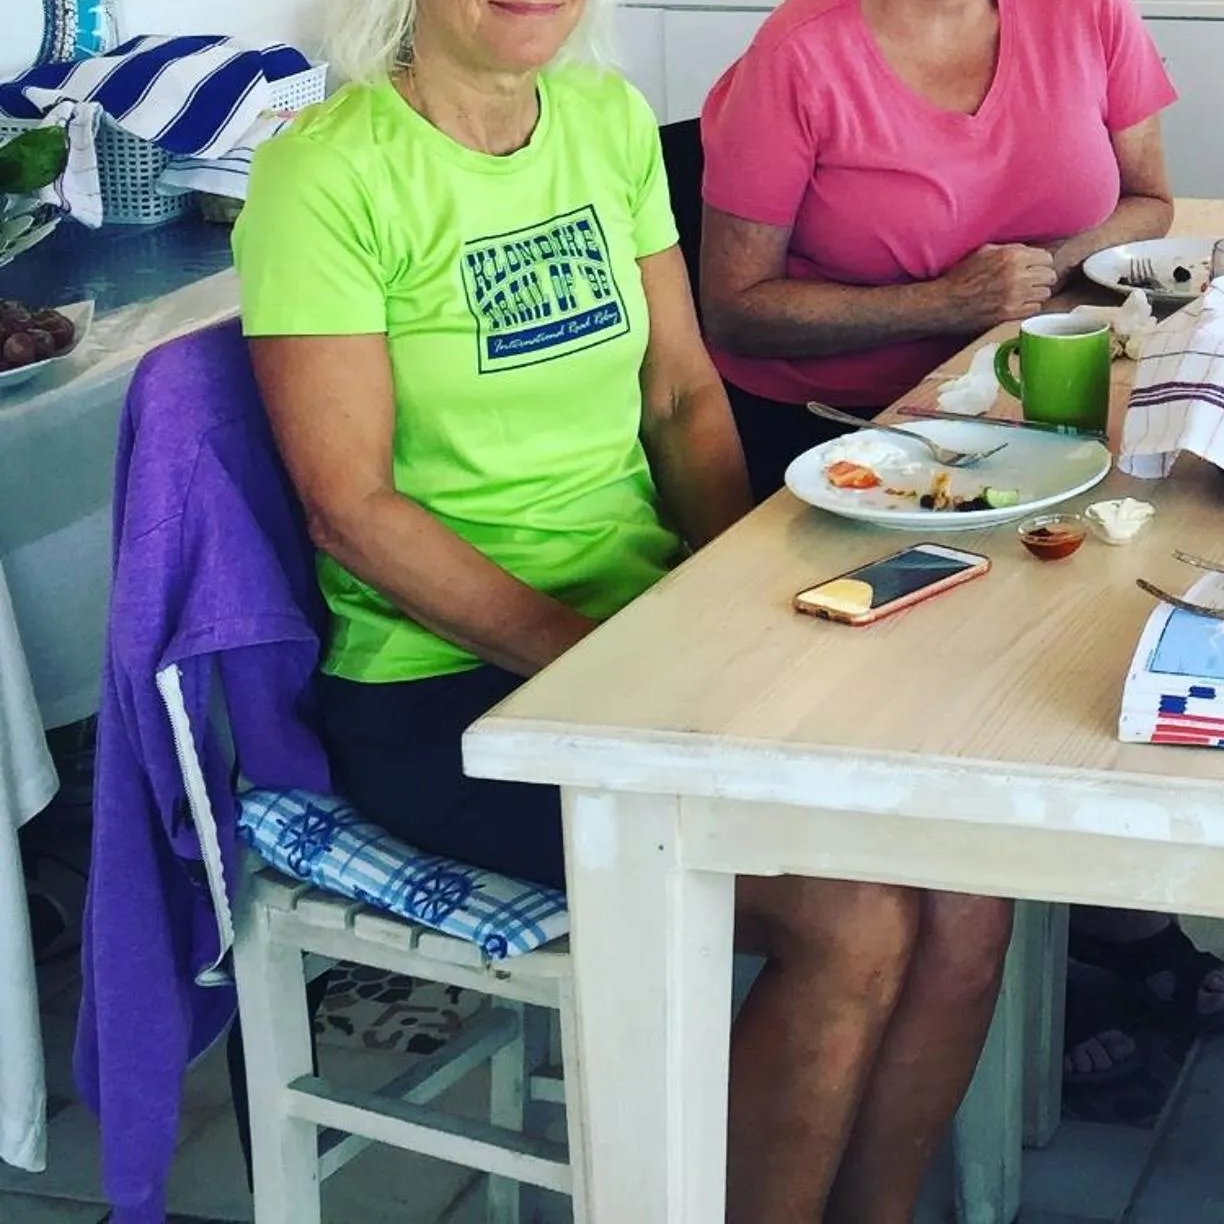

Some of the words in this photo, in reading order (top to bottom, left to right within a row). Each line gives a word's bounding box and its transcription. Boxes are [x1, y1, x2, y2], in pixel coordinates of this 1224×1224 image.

[467, 219, 603, 302] KLONDIKE
[482, 272, 552, 329] TRAIL
[549, 262, 577, 311] OF
[493, 324, 566, 353] International
